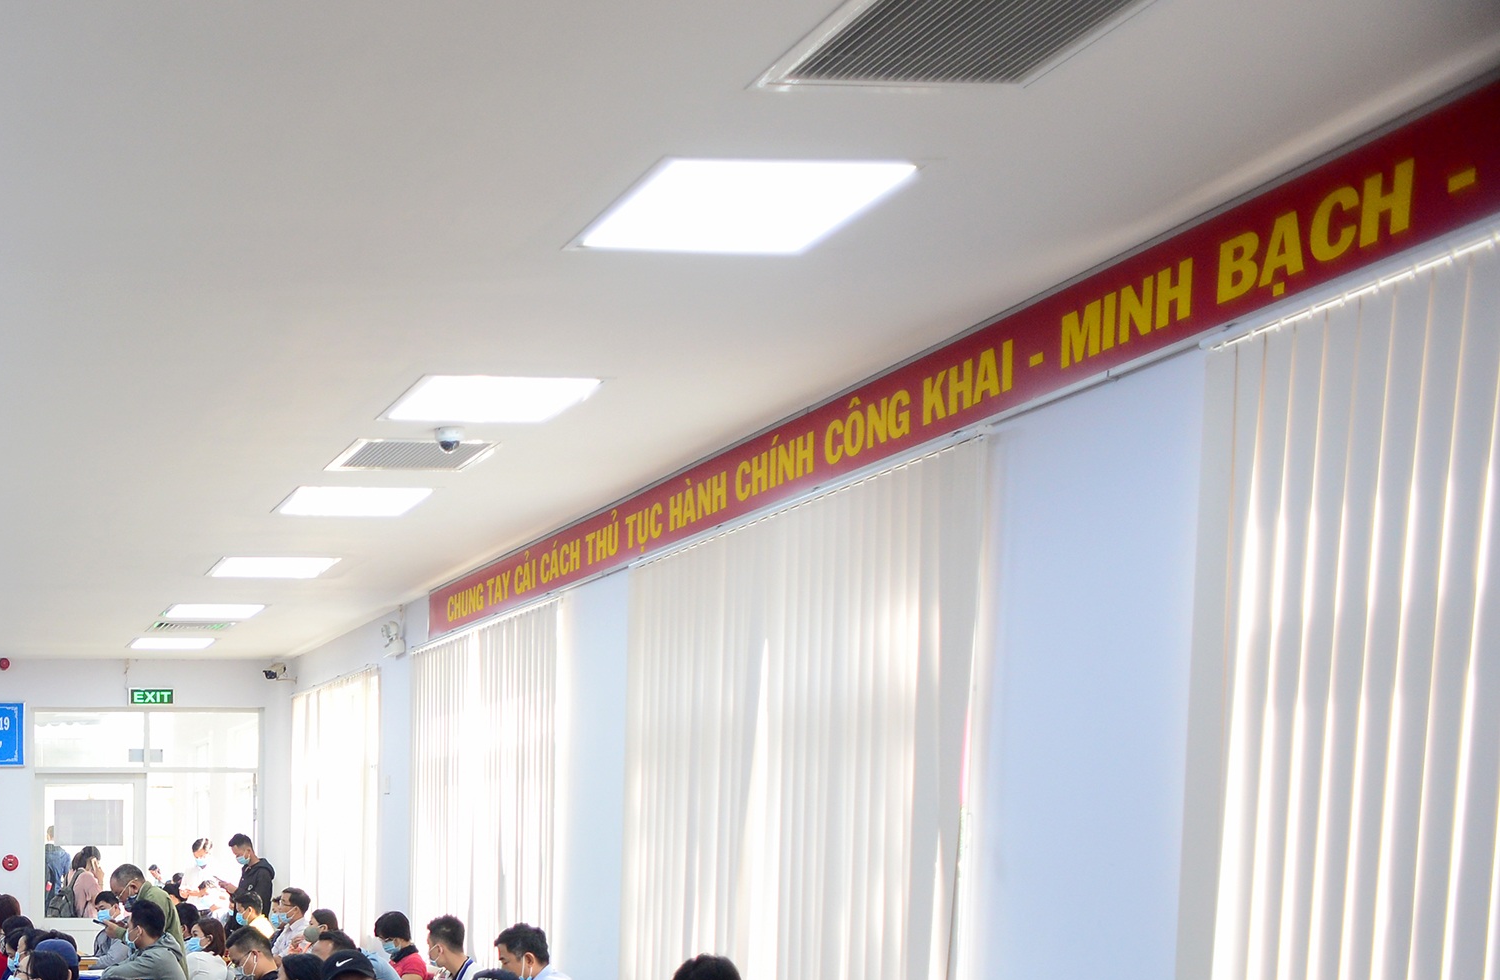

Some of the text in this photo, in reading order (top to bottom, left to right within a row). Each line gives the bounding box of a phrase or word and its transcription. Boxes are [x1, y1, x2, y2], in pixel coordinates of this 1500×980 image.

[446, 582, 485, 623] CHUNG
[486, 569, 511, 606] TAY
[514, 549, 537, 595] CẢI
[540, 540, 581, 584] CÁCH
[585, 508, 619, 566] THỦ
[625, 502, 663, 552] TỤC
[669, 471, 727, 532] HÀNH
[735, 430, 814, 502] CHÍNH
[824, 389, 911, 466] CÔNG
[922, 338, 1014, 427] KHAI
[1060, 257, 1193, 370] MINH
[1216, 157, 1415, 305] BẠCH
[133, 691, 172, 703] EXIT
